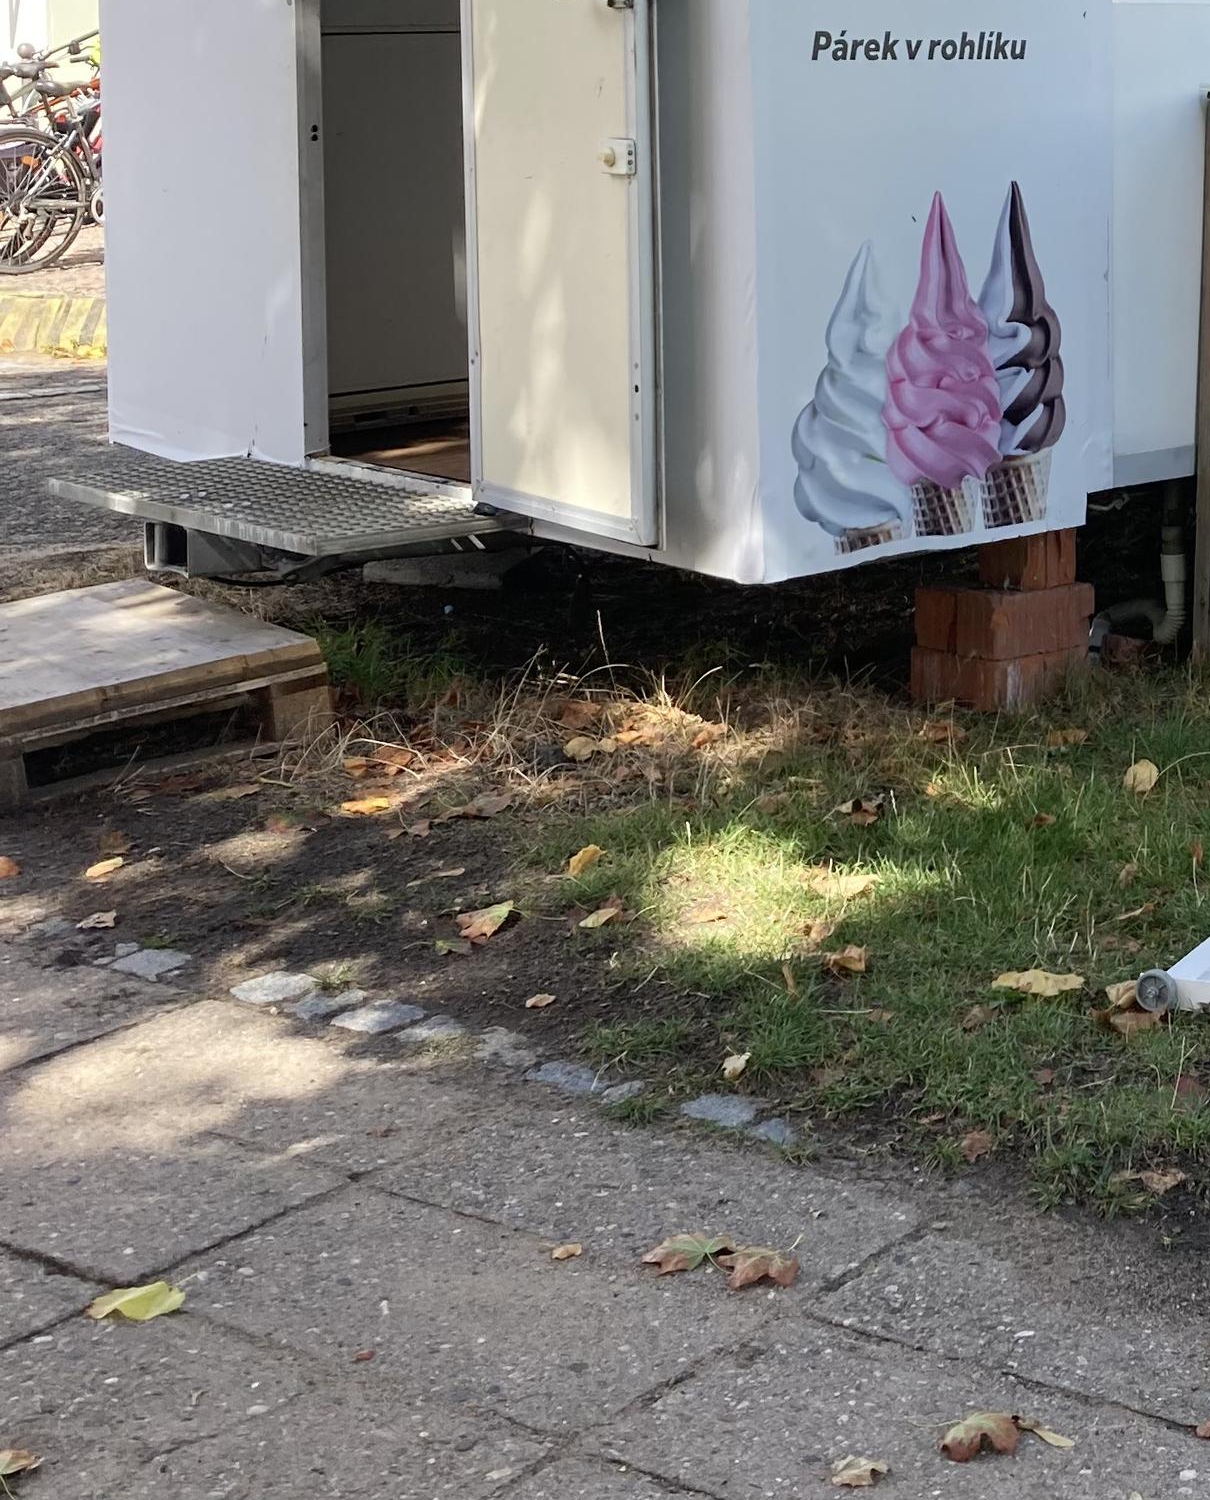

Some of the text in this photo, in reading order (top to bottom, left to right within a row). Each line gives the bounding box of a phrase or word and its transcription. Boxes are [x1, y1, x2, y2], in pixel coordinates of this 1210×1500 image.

[811, 30, 1027, 62] Párek v rohlíku
